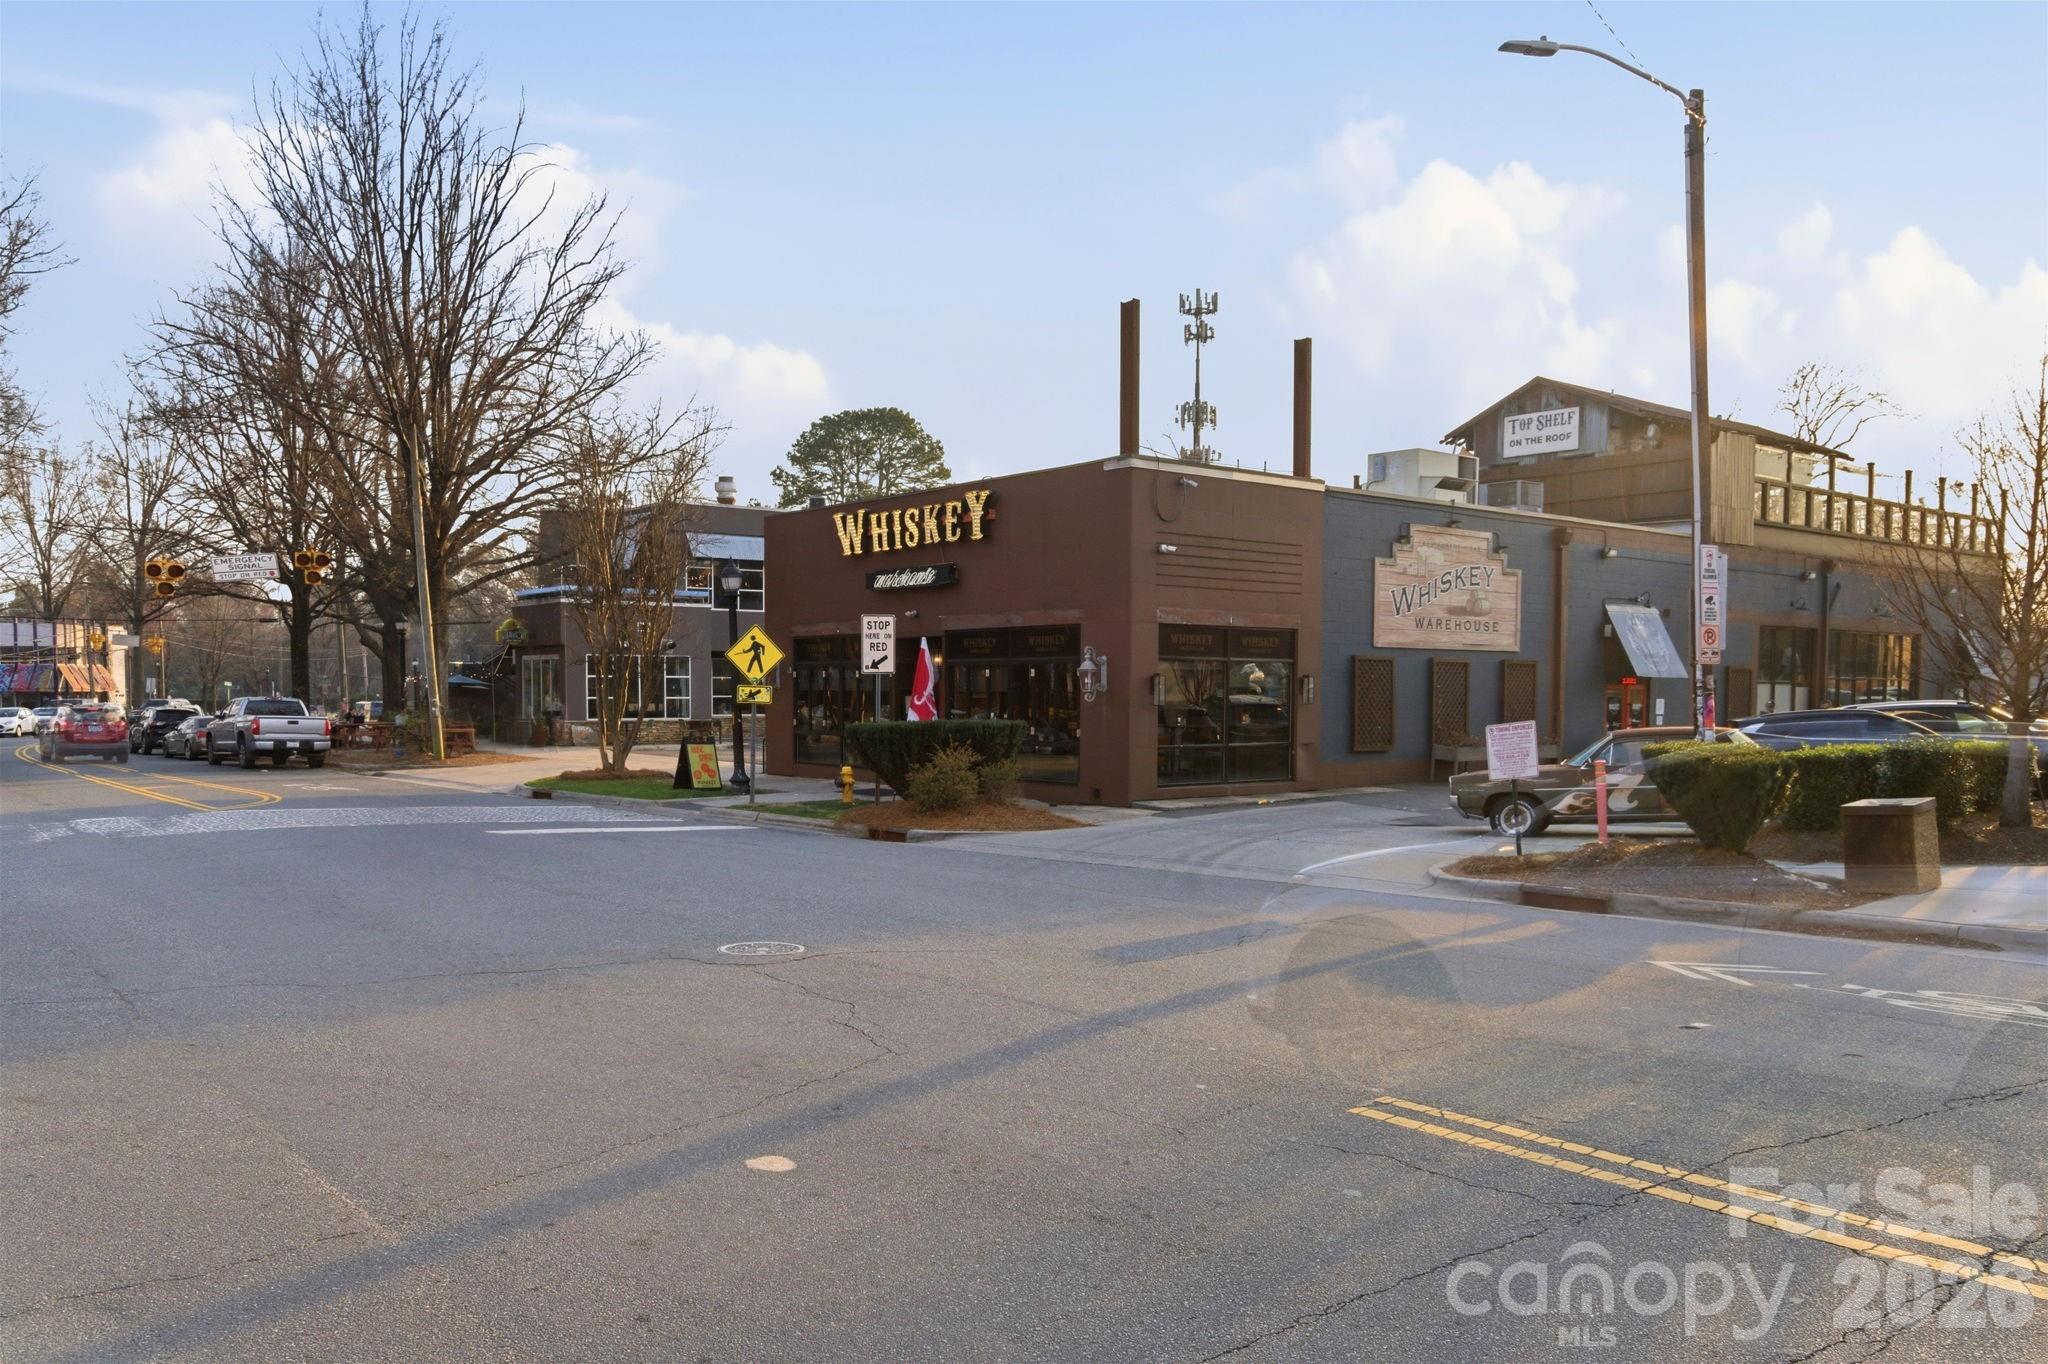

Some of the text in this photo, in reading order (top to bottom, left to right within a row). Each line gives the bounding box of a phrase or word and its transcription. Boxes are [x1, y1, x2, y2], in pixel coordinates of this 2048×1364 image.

[1508, 411, 1576, 435] TOP SHELF
[1509, 432, 1572, 448] ON THE ROOF
[832, 489, 991, 556] WHISKEY
[213, 555, 273, 566] EMERGENCY
[228, 563, 263, 571] SIGNAL
[1389, 565, 1496, 617] WHISKEY
[866, 620, 891, 630] STOP
[1415, 617, 1499, 632] WAREHOUSE
[1170, 633, 1213, 645] WHISKEY
[869, 642, 888, 652] RED
